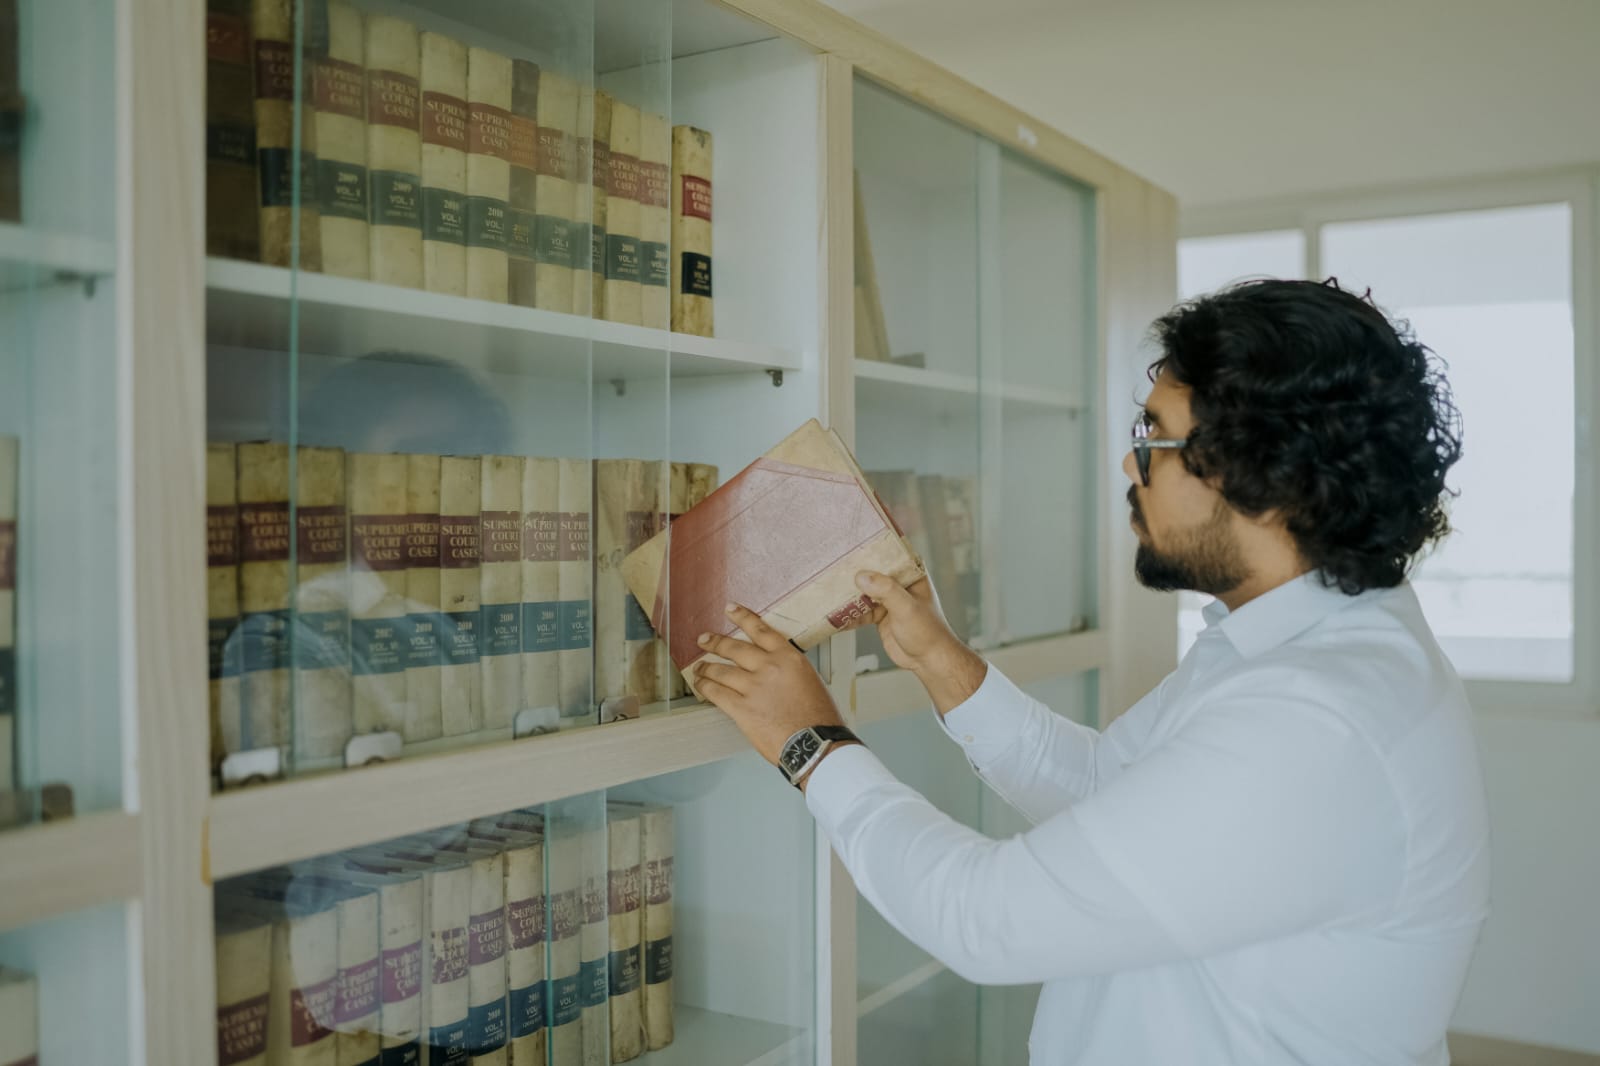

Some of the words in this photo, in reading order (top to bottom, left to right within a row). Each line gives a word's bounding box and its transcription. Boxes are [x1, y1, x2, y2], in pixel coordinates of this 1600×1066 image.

[426, 100, 466, 119] SUPREM
[481, 135, 509, 152] CASES
[441, 524, 480, 536] SUPREM
[483, 519, 520, 530] SUPREM
[363, 536, 401, 548] COURT
[492, 542, 519, 553] CASES
[366, 549, 401, 560] CASES
[408, 547, 439, 558] CASES
[452, 548, 480, 559] CASES
[470, 916, 504, 935] SUPREM
